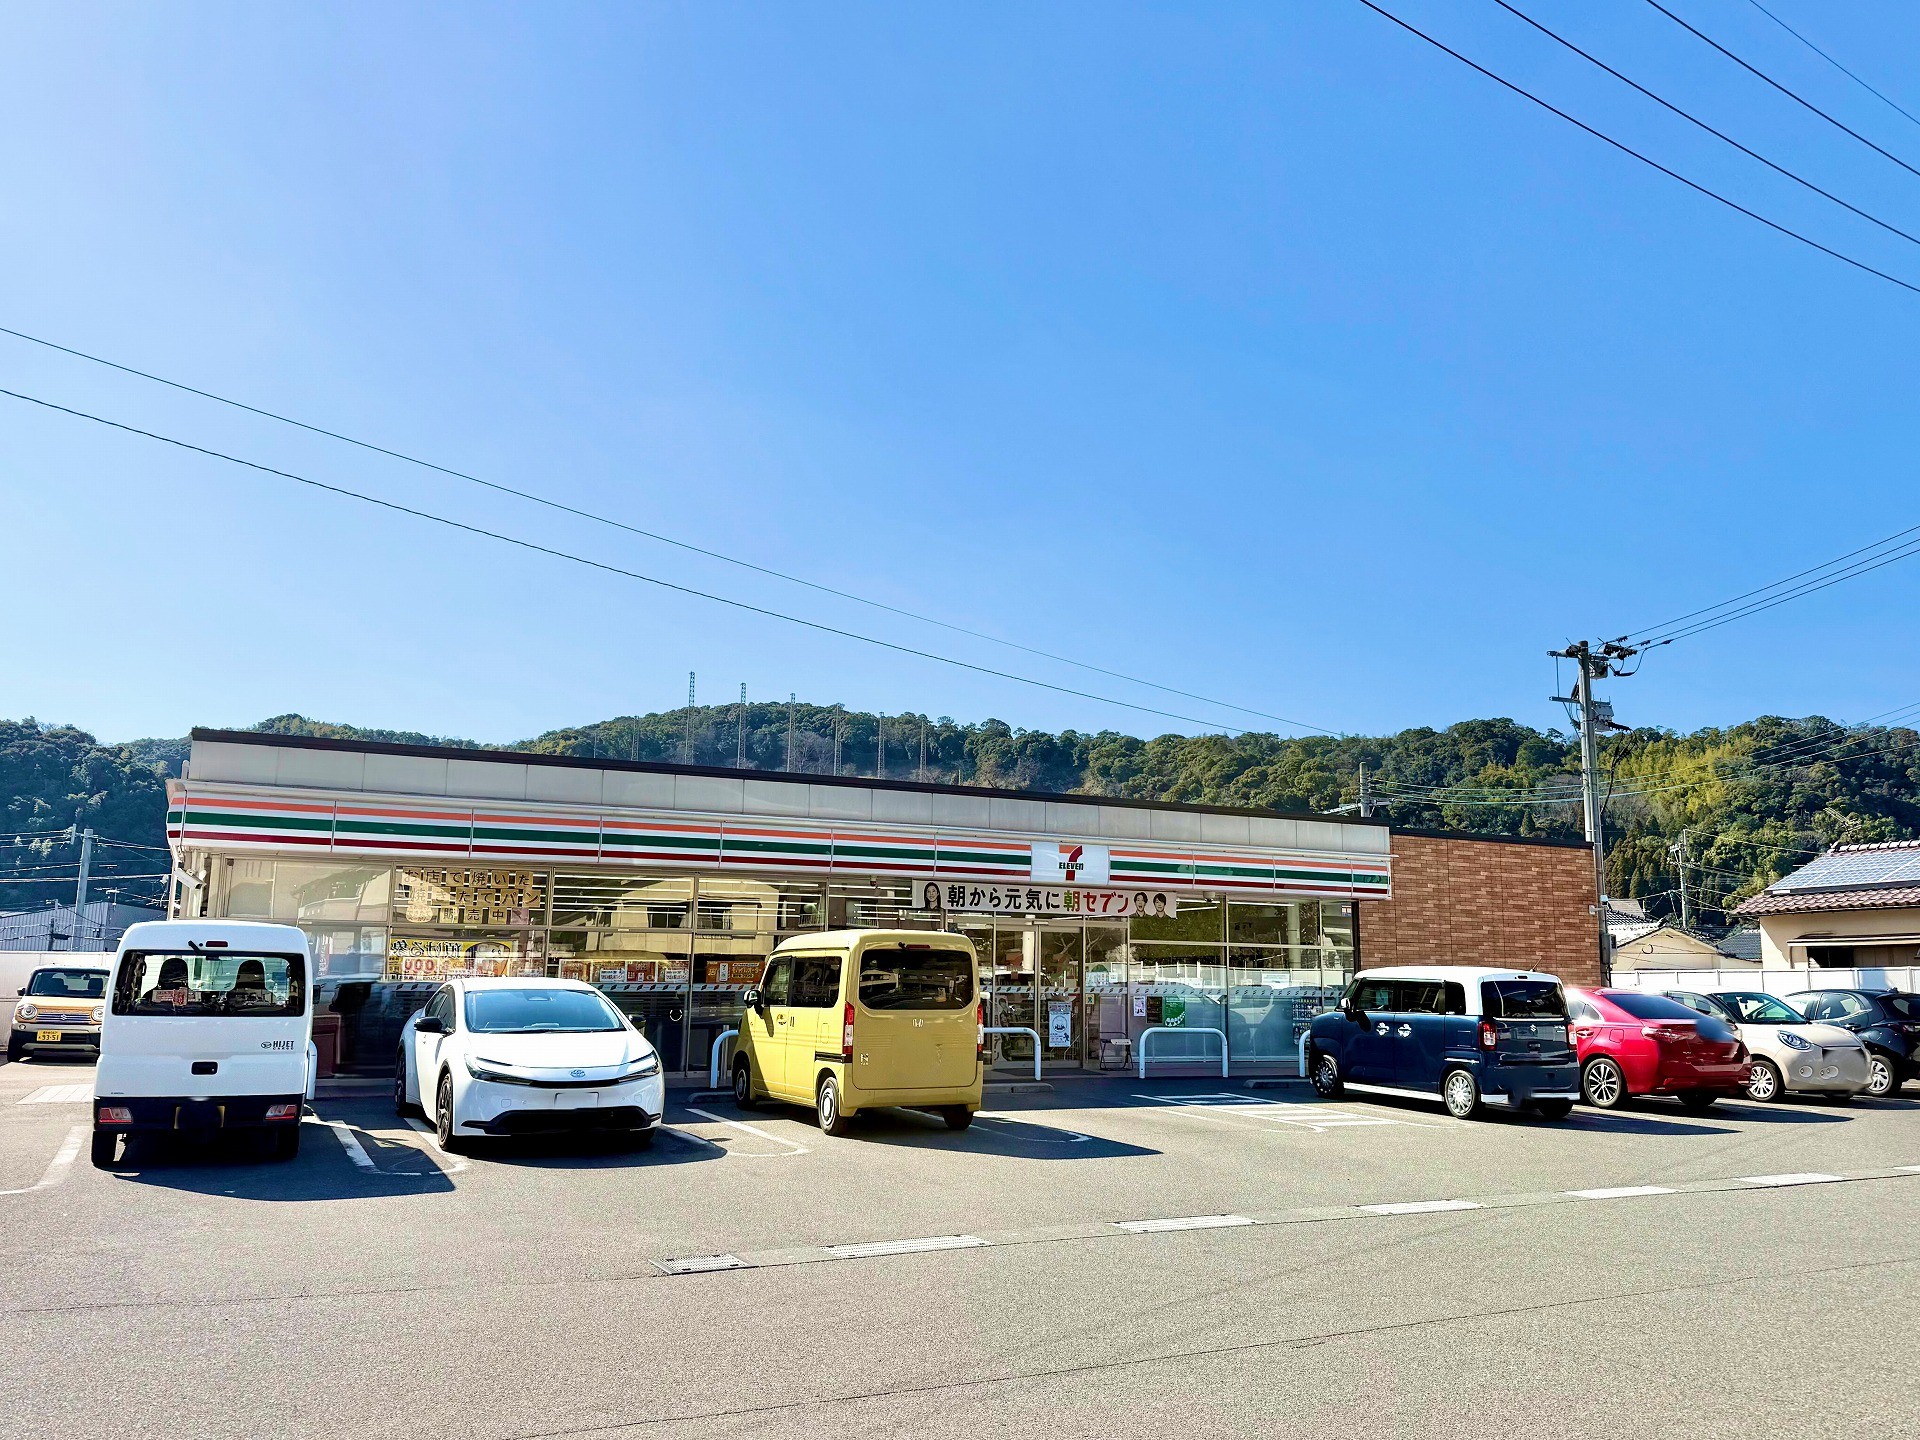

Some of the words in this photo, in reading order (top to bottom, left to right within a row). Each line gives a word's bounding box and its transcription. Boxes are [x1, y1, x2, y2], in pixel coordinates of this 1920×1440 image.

[404, 869, 529, 886] お店で焼いた
[947, 884, 1129, 913] 朝から元気に朝セブン
[272, 1040, 294, 1048] HIJET
